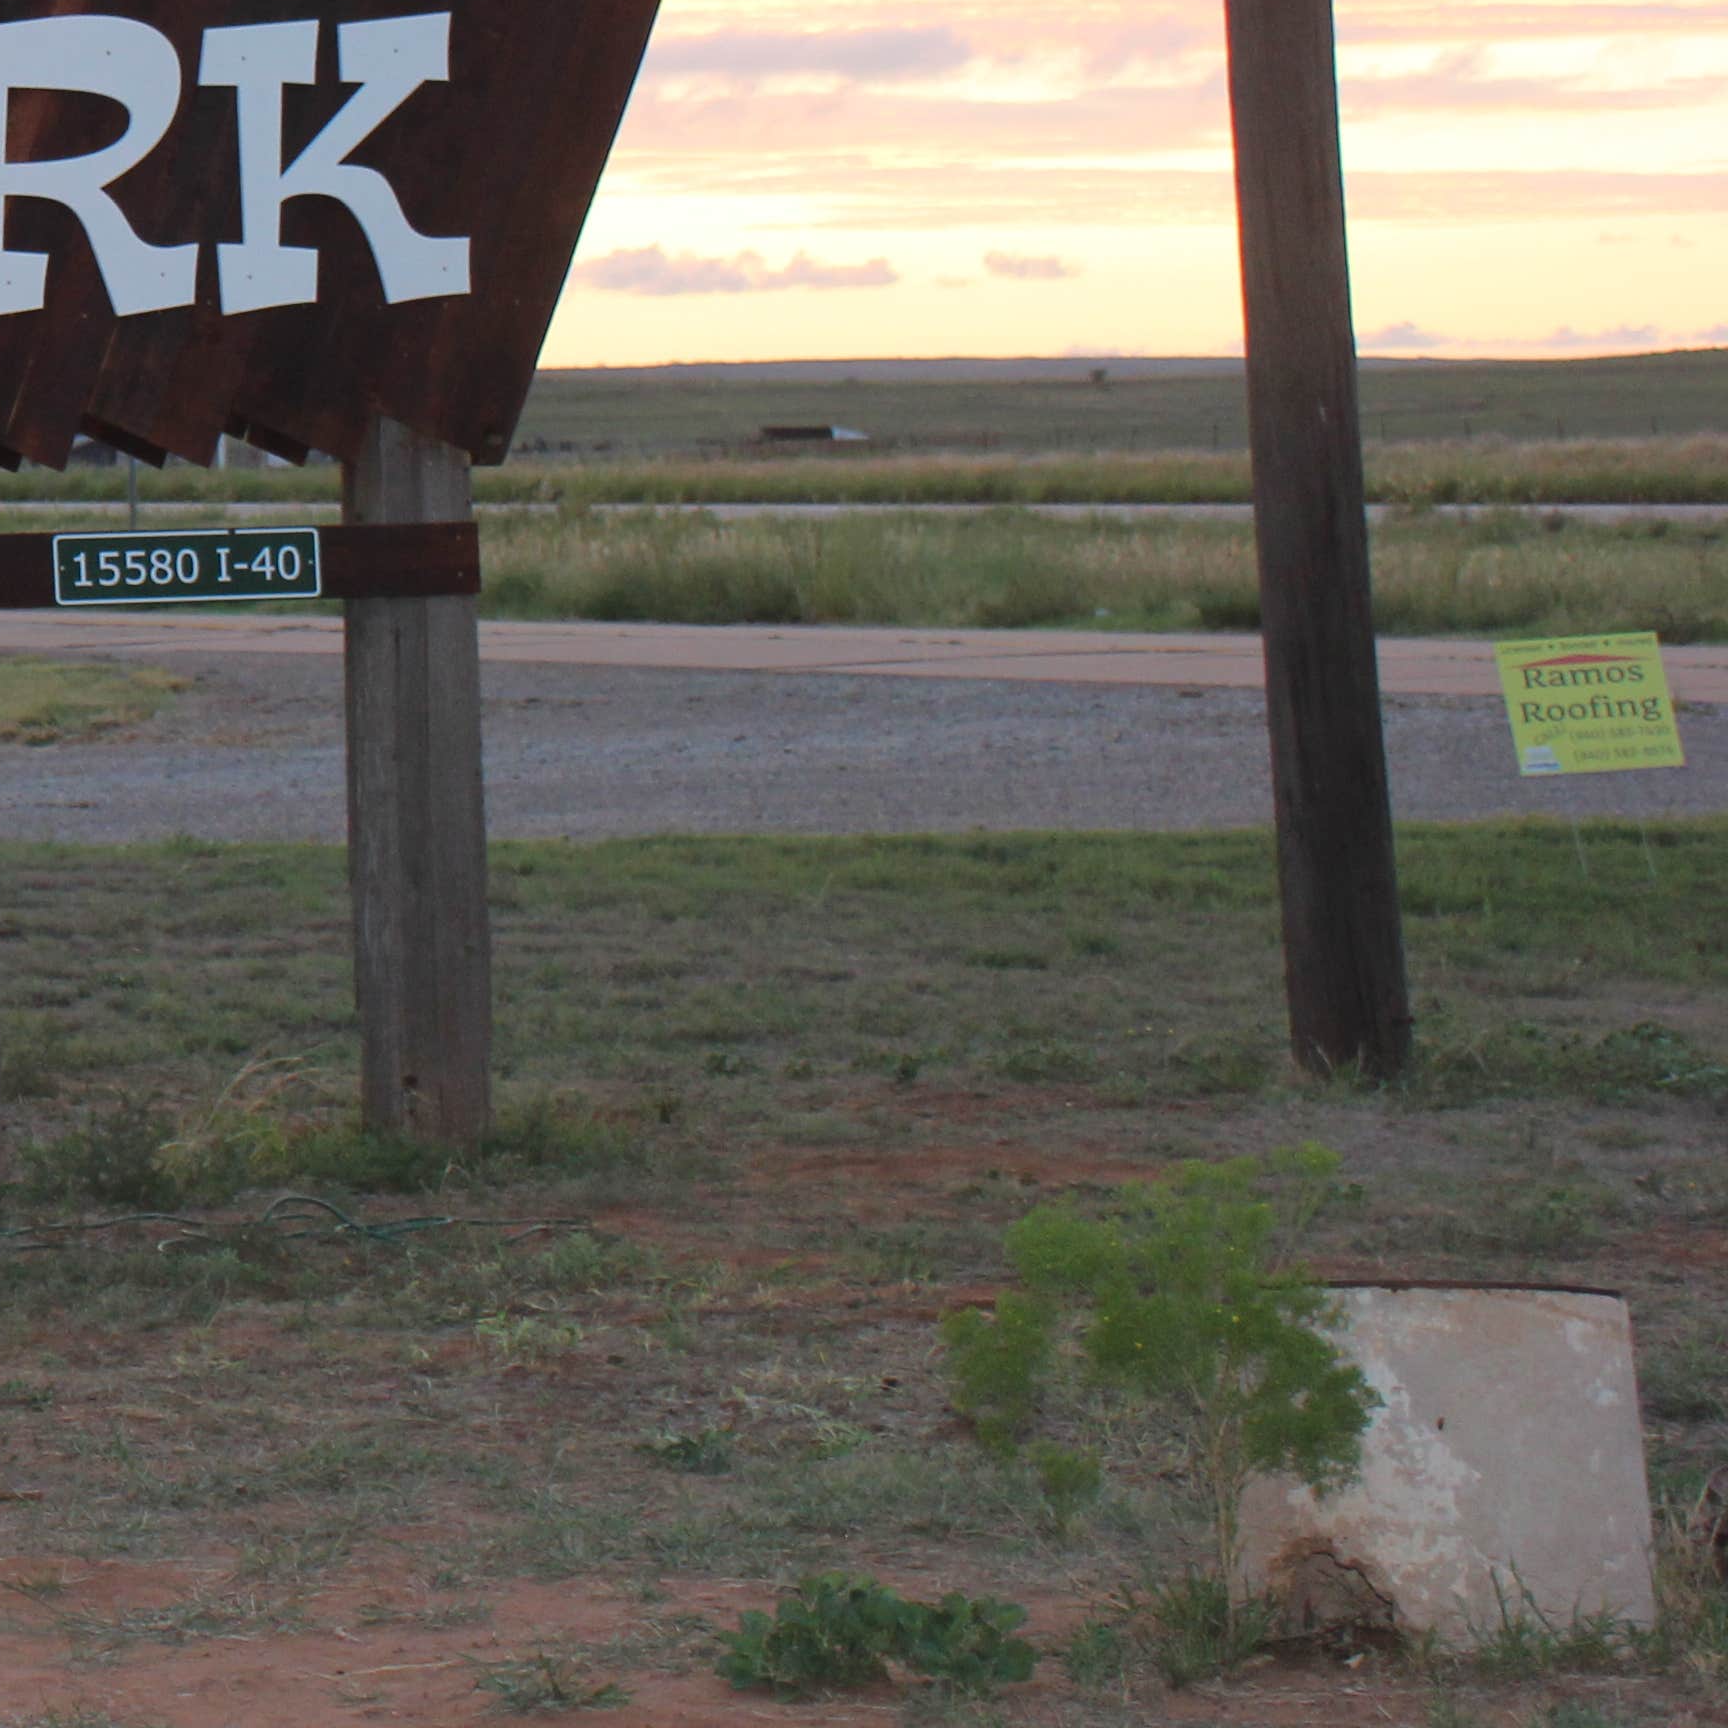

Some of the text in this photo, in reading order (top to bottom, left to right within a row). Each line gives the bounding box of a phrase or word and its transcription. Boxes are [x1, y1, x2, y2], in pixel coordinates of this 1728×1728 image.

[72, 544, 302, 588] 15580 I-40
[1522, 663, 1645, 690] Ramos
[1519, 694, 1662, 724] Roofing
